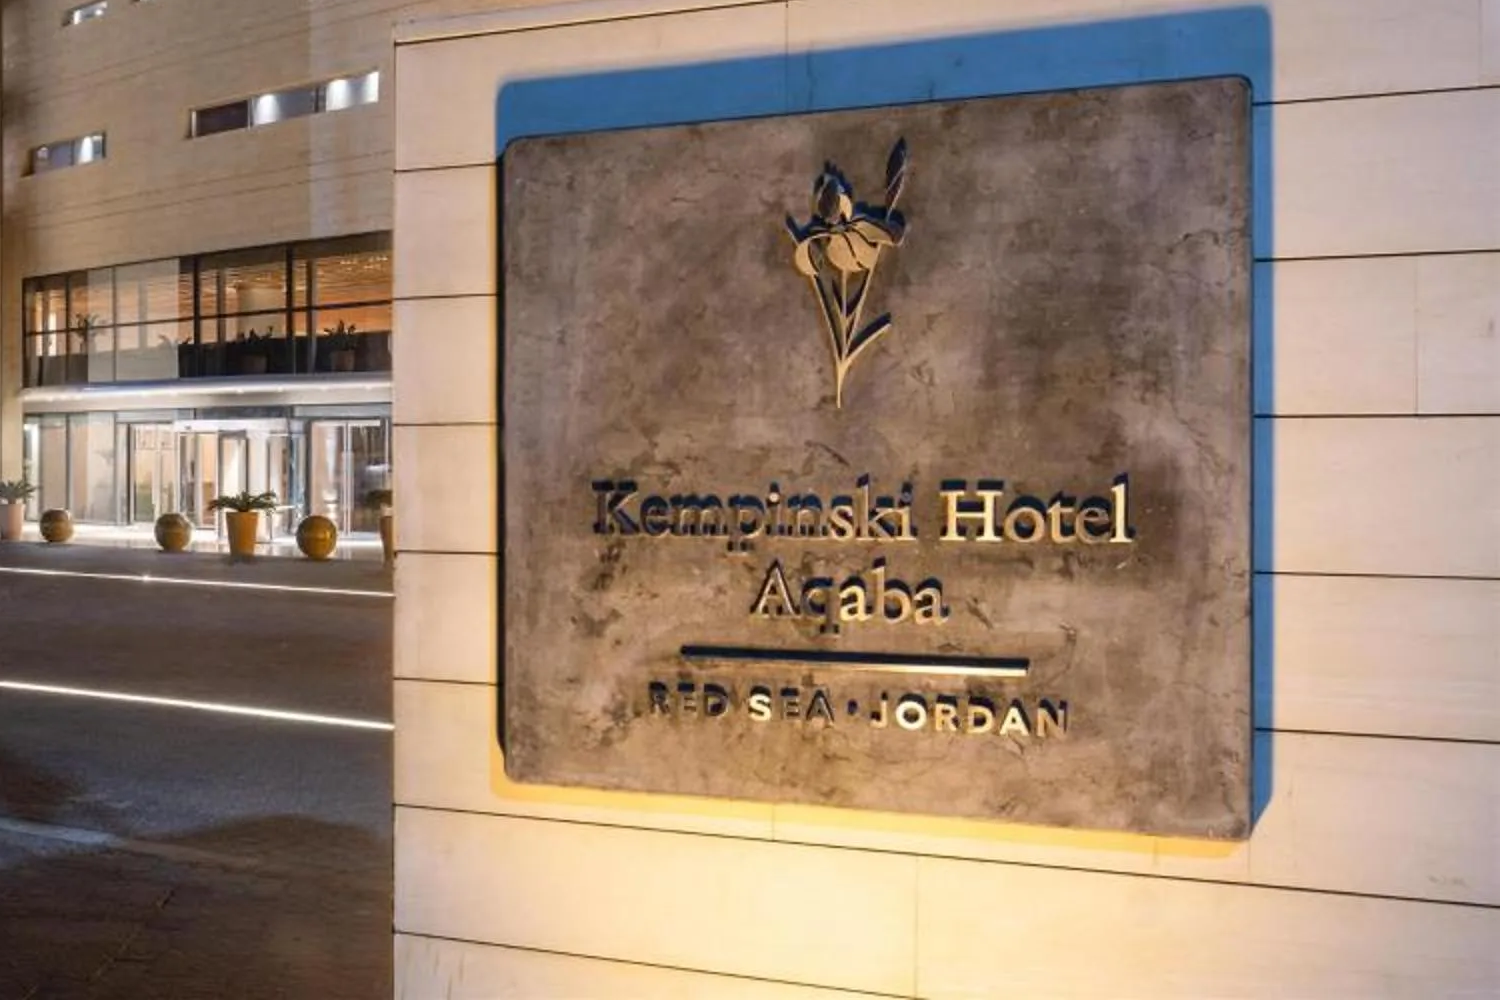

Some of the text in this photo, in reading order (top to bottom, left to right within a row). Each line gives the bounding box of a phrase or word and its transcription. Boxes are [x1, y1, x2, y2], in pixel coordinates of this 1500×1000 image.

[591, 472, 1137, 556] Kempinski Hotel
[749, 556, 951, 635] Aqaba
[648, 680, 1070, 737] RED SEA JORDAN
